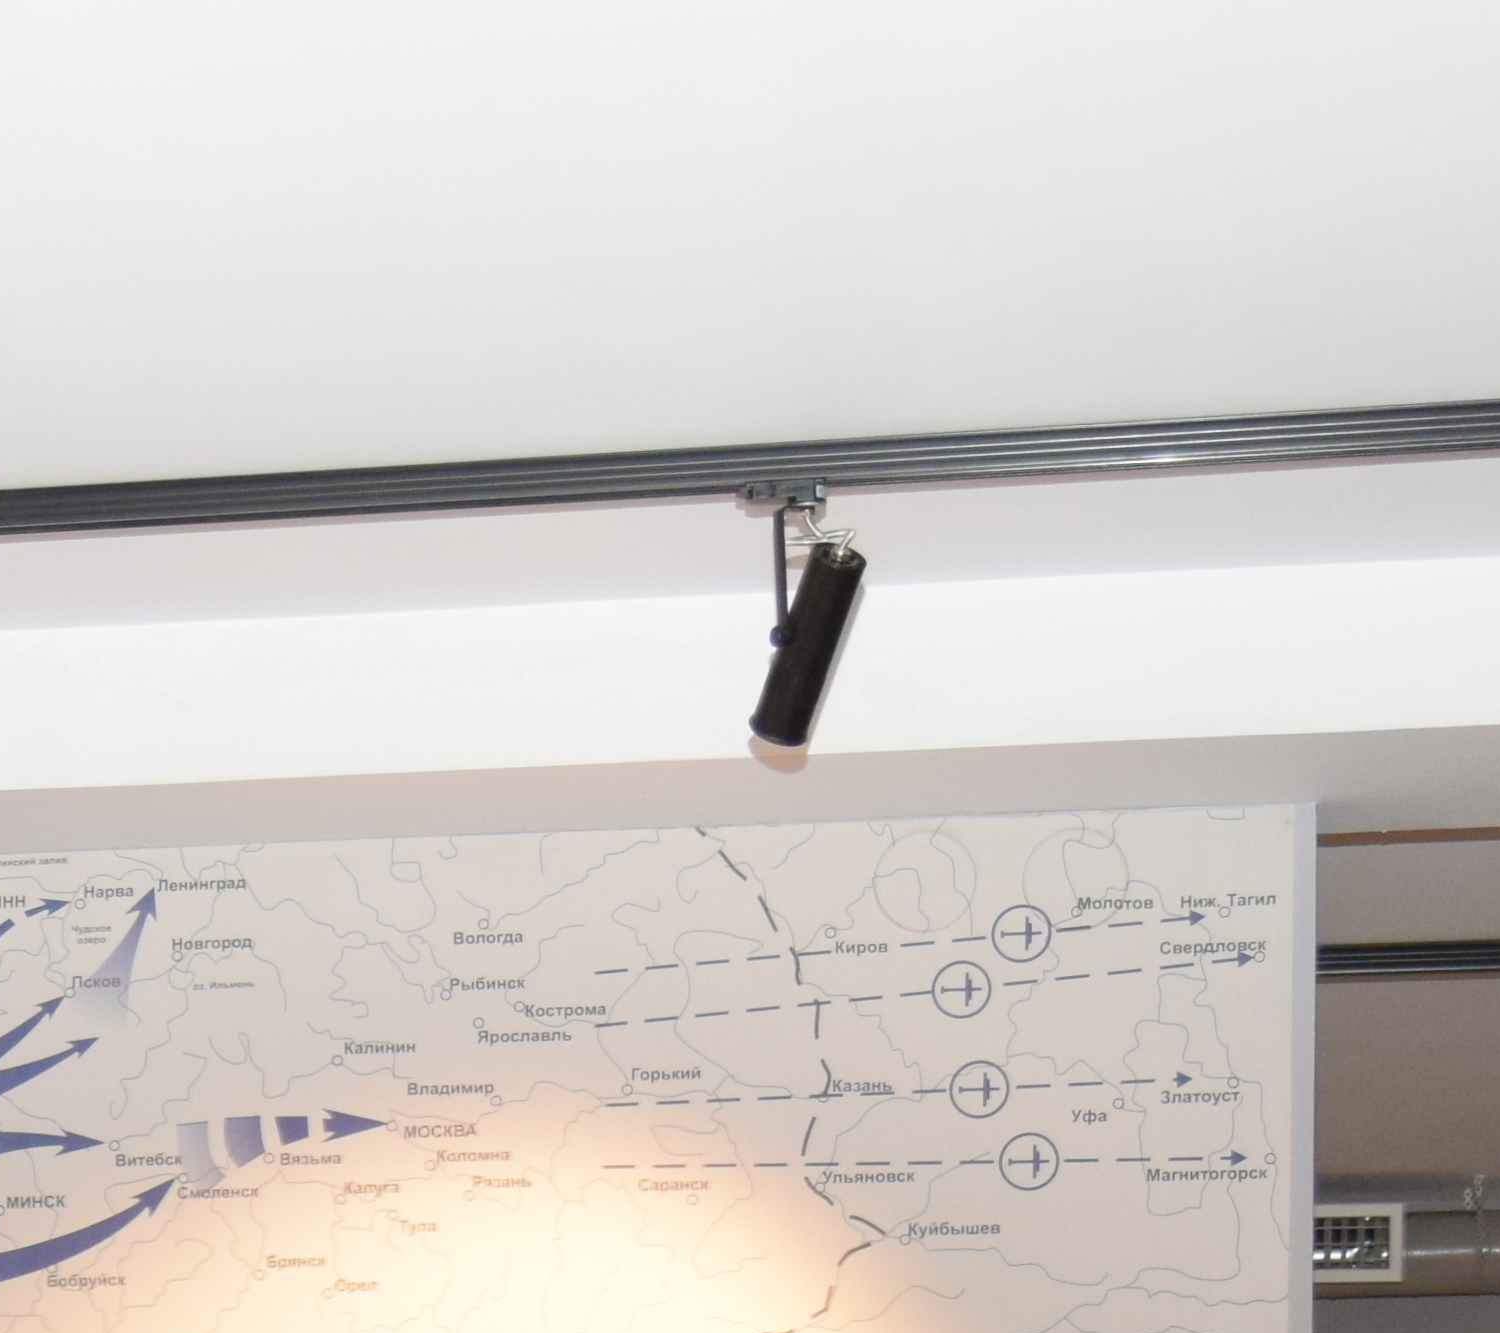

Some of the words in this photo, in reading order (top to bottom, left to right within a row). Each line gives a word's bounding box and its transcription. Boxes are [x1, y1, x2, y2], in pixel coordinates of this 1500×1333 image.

[84, 885, 134, 900] Нарва
[156, 876, 247, 895] Ленинград
[1077, 896, 1154, 911] Молотов
[1180, 894, 1220, 910] Ниж.
[1225, 892, 1276, 908] Тагил
[171, 935, 252, 953] Новгород
[453, 930, 523, 947] Вологда
[835, 940, 888, 956] Киров
[1159, 938, 1267, 957] Свердловск
[71, 974, 121, 990] Псков
[448, 976, 526, 992] Рыбинск
[525, 1003, 607, 1019] Кострома
[477, 1029, 572, 1046] Ярославль
[343, 1041, 416, 1056] Калинин
[631, 1066, 702, 1083] Горький
[407, 1082, 495, 1098] Владимир
[832, 1079, 892, 1094] Казань
[1160, 1089, 1239, 1106] Златоуст
[1071, 1110, 1108, 1125] Уфа
[403, 1123, 477, 1139] МОСКВА
[115, 1151, 183, 1168] Витебск
[280, 1151, 342, 1166] Вязьма
[823, 1170, 915, 1185] Ульяновск
[1146, 1166, 1268, 1184] Магнитогорск
[177, 1184, 259, 1201] Смоленск
[6, 1194, 66, 1210] МИНСК
[907, 1221, 1001, 1239] Куйбышев
[47, 1272, 126, 1291] Бобруйск
